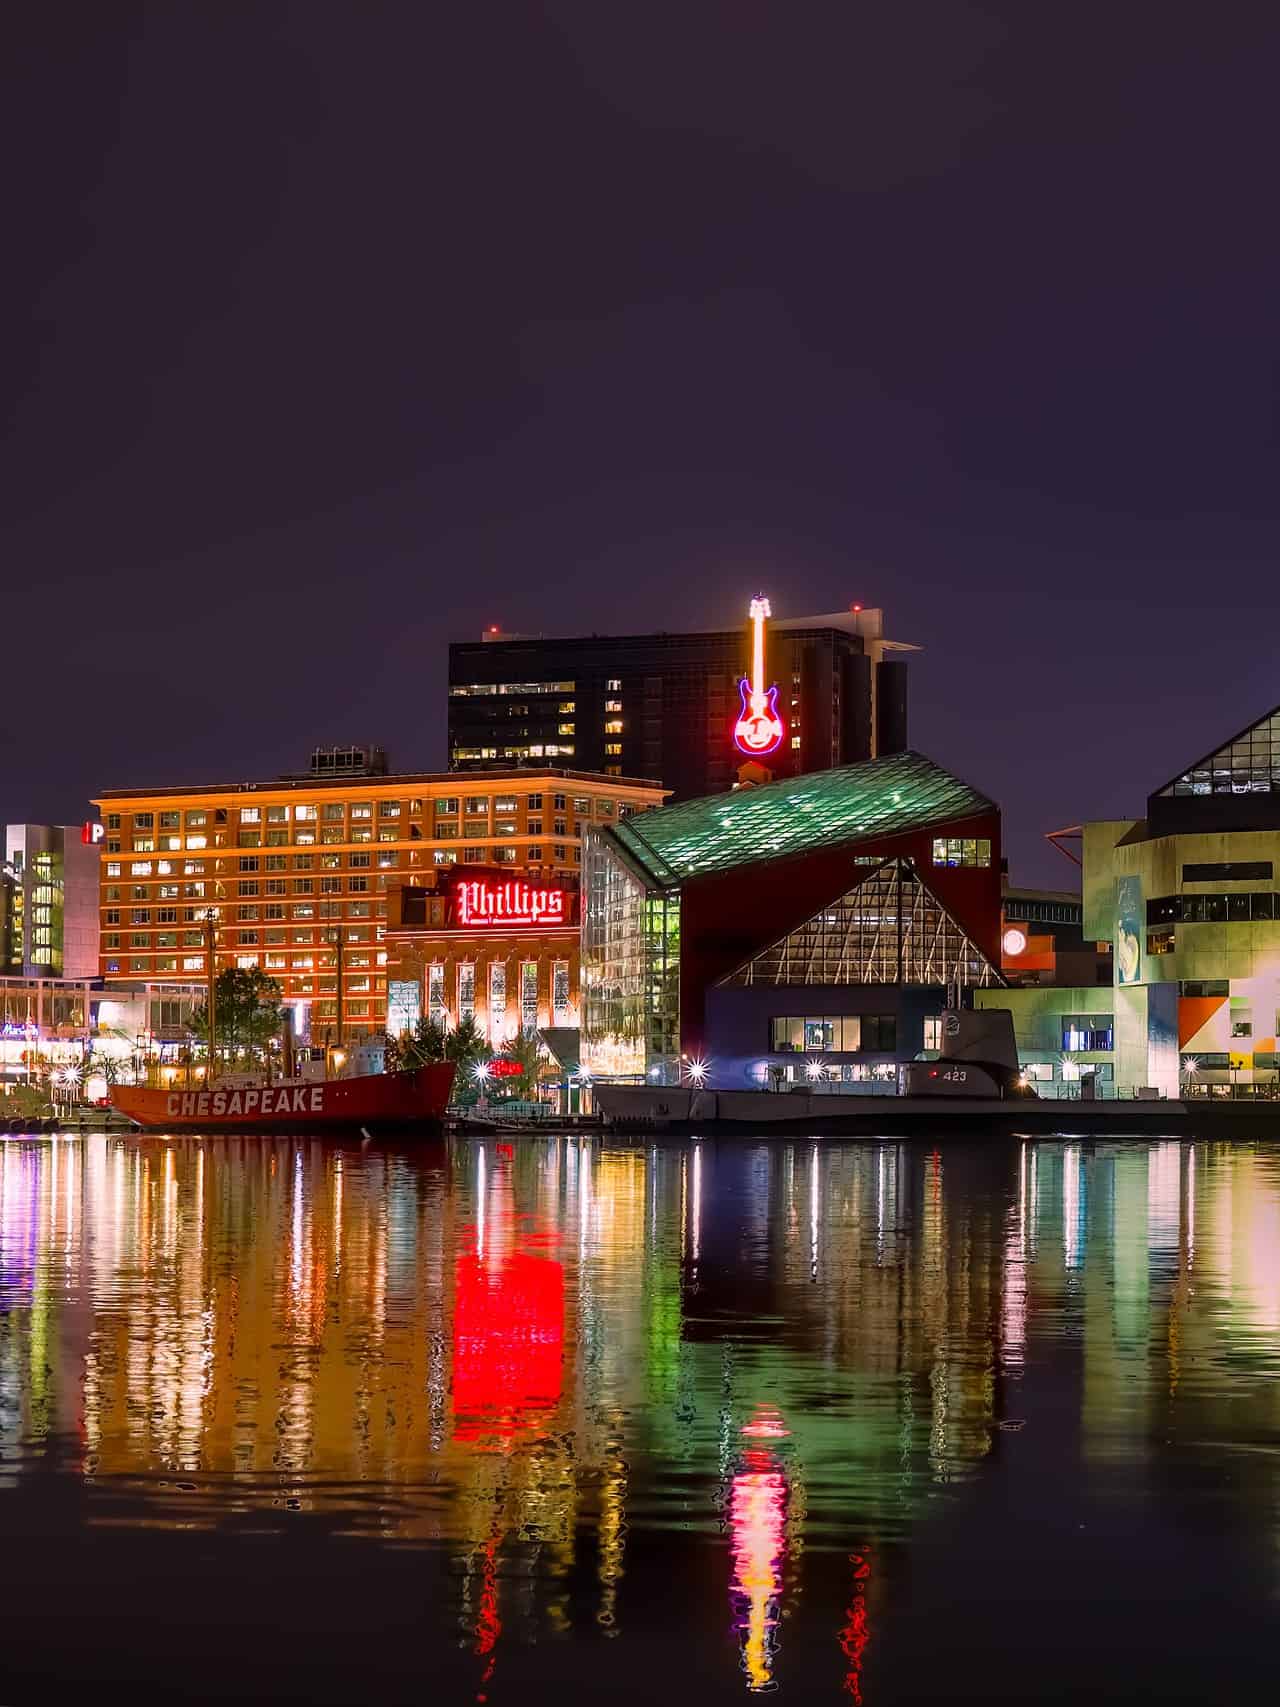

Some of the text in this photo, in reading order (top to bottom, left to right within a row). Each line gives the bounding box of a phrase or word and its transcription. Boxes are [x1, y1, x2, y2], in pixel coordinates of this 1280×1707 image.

[92, 823, 105, 843] P
[457, 881, 563, 924] Phillips
[943, 1071, 967, 1081] 423
[167, 1087, 324, 1116] CHESAPEAKE
